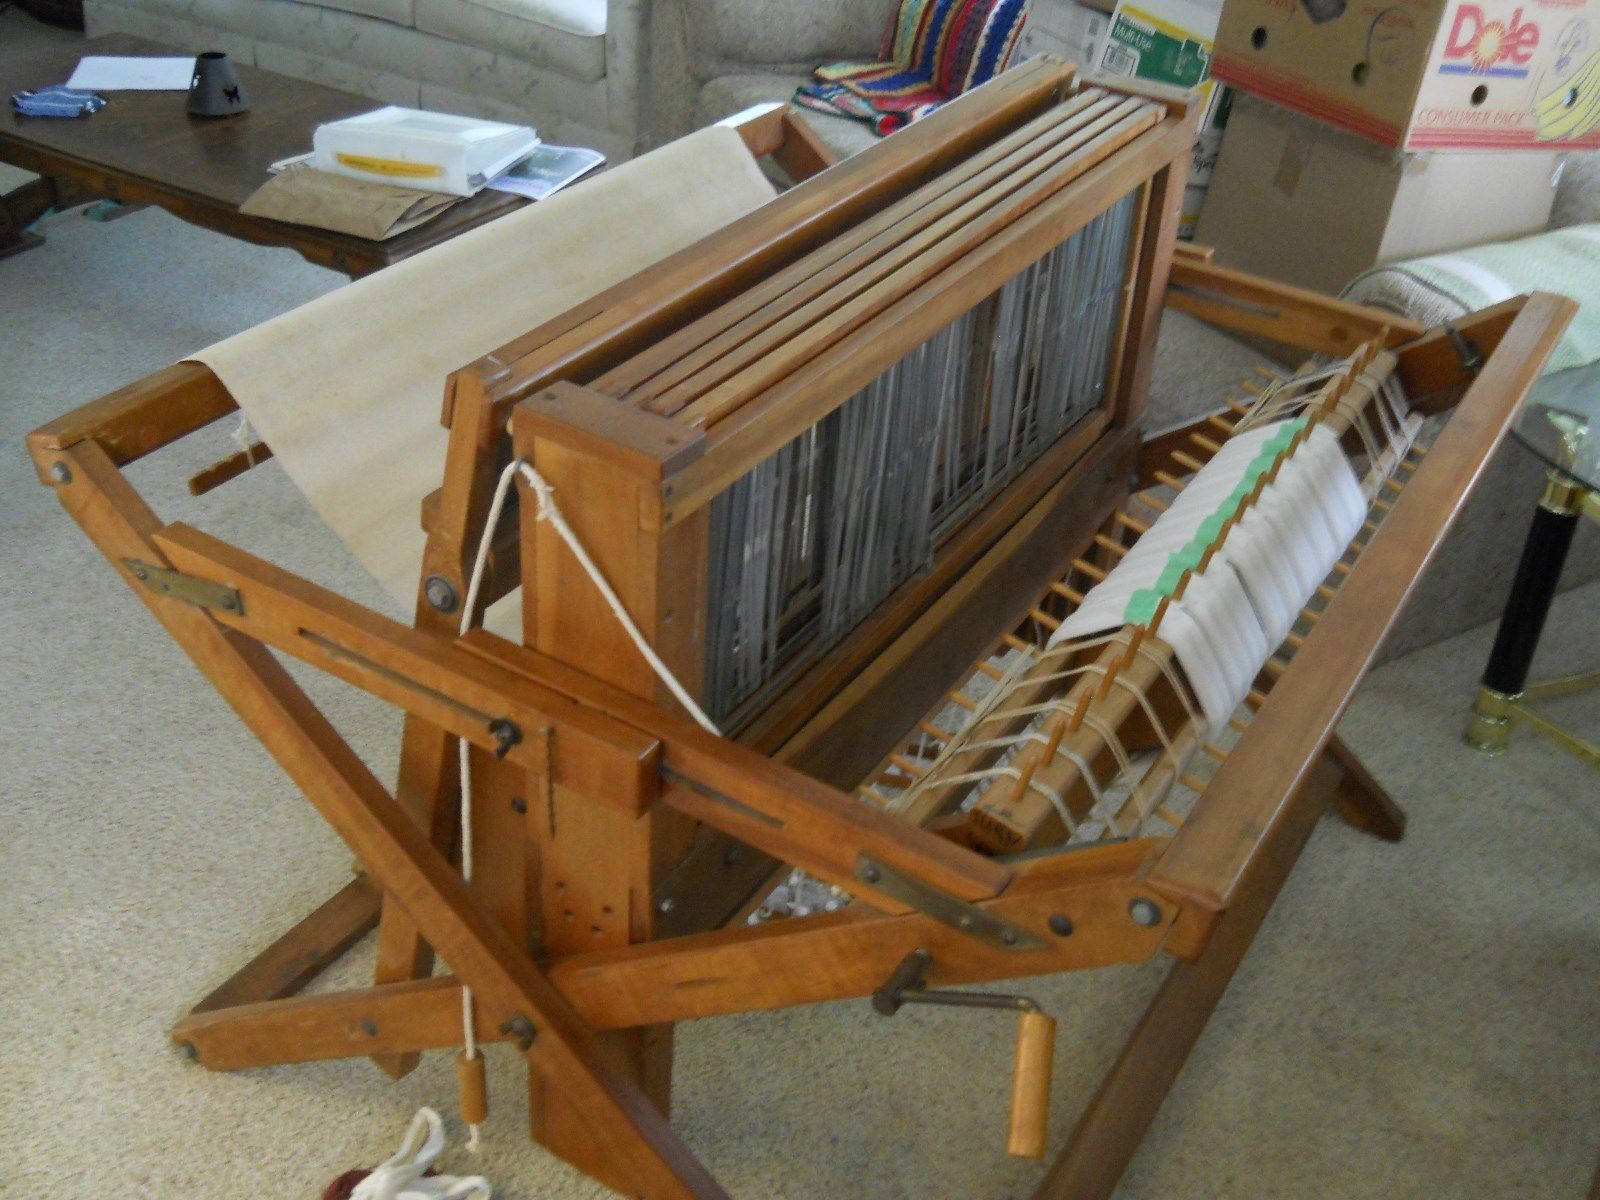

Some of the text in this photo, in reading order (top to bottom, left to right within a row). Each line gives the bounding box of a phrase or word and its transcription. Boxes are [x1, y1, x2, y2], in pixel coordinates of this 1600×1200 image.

[1444, 4, 1540, 65] Dole
[1417, 109, 1528, 126] CONSUMER PACK
